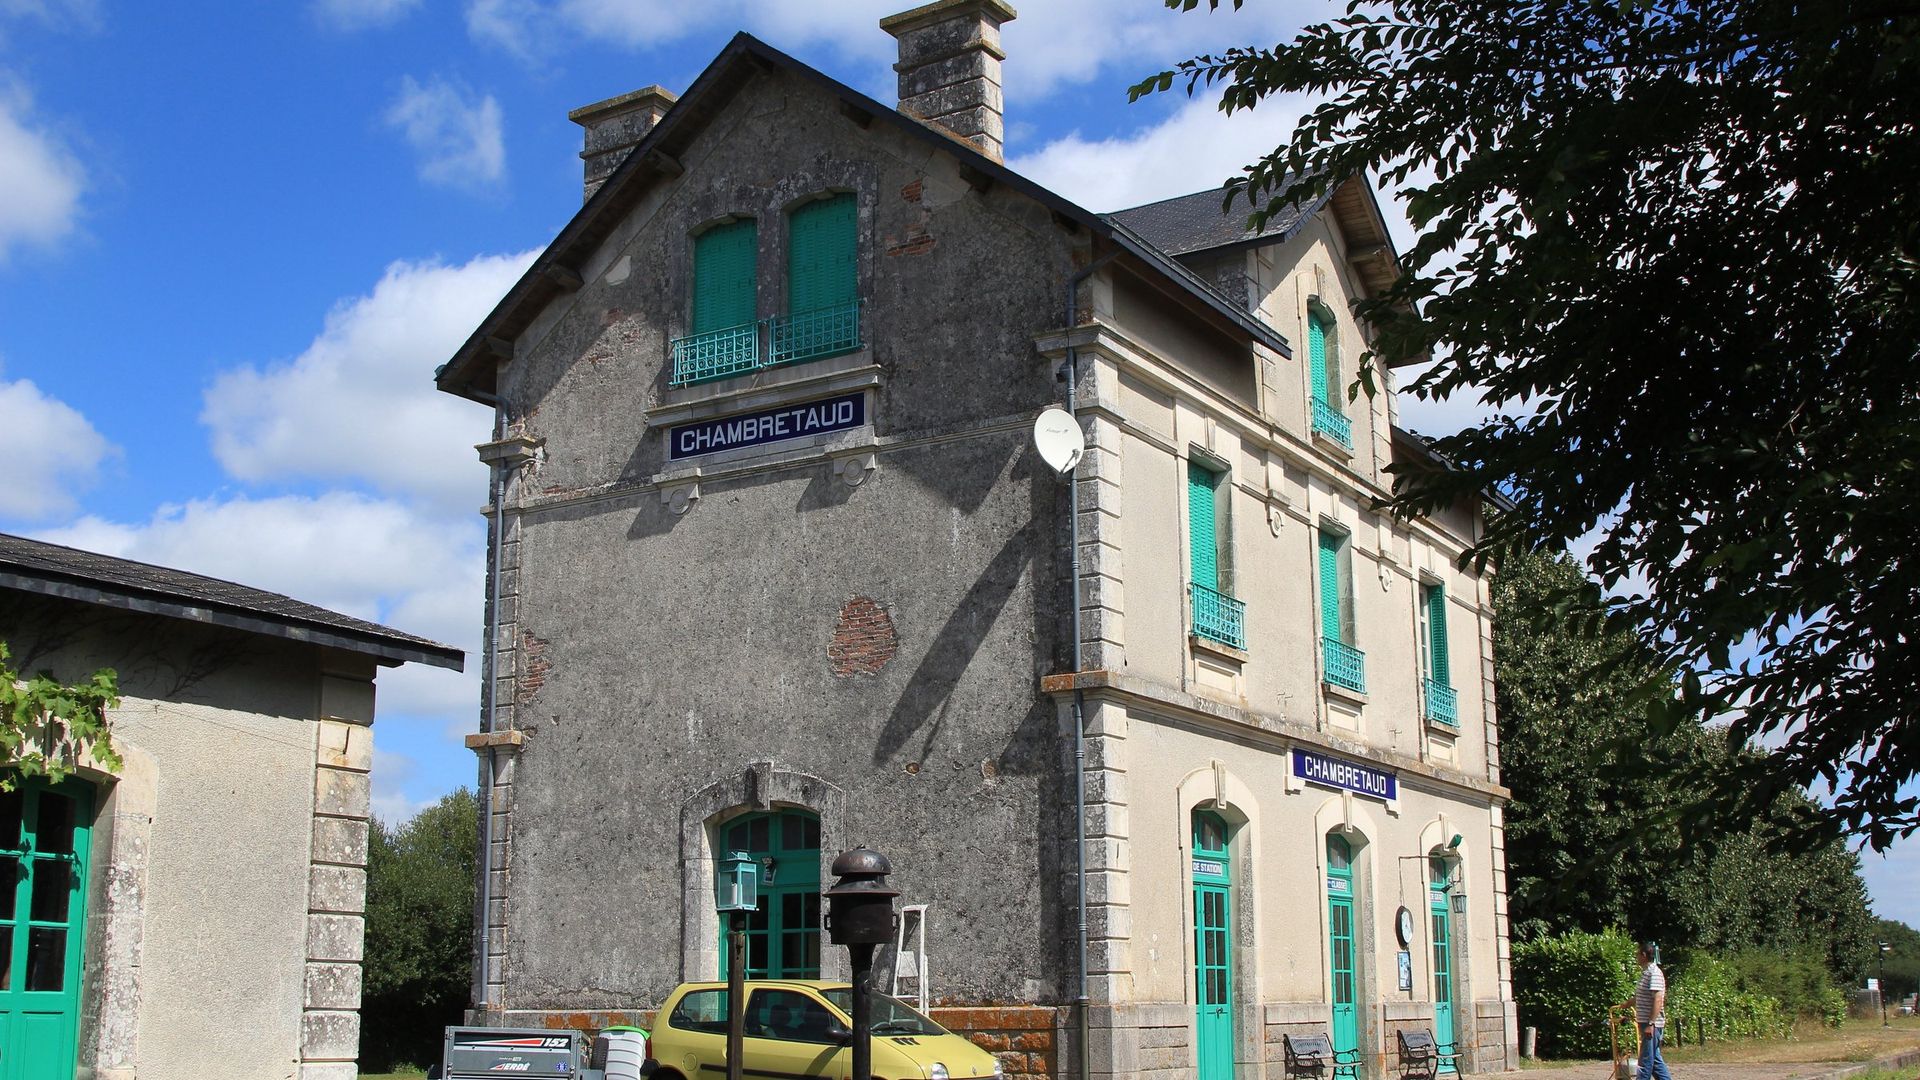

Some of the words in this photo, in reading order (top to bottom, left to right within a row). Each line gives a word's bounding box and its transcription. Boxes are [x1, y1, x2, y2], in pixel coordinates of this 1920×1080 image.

[680, 400, 854, 452] CHAMBRETAUD
[1304, 756, 1387, 795] CHAMBRETAUD
[1201, 863, 1221, 873] STATION
[543, 1038, 569, 1048] 152
